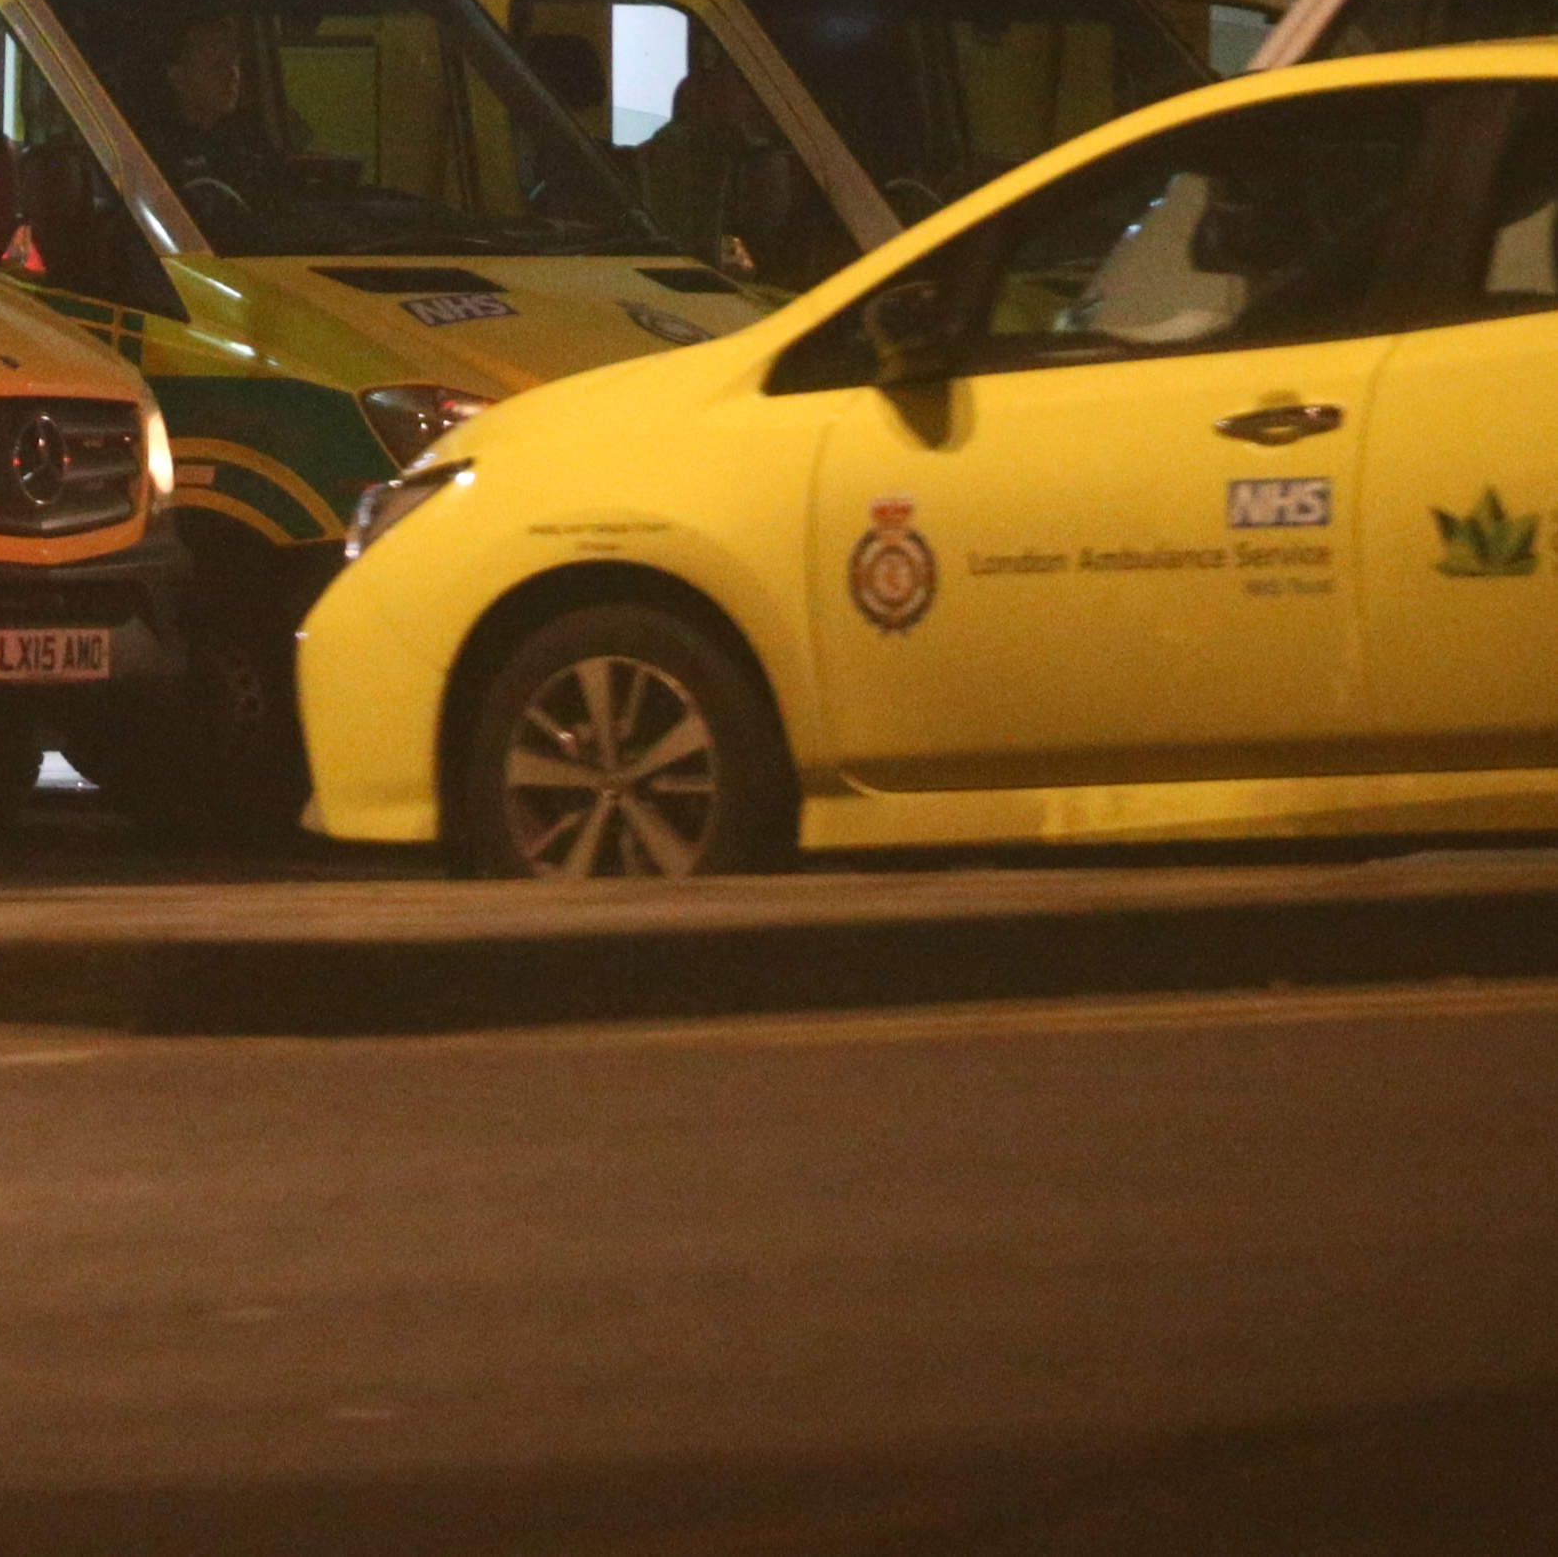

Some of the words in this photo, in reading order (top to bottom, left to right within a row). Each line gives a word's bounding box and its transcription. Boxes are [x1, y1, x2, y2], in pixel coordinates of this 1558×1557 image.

[413, 294, 509, 325] NHS
[1230, 482, 1329, 524] NHS
[1078, 542, 1226, 572] Ambulance
[1234, 539, 1332, 568] Service
